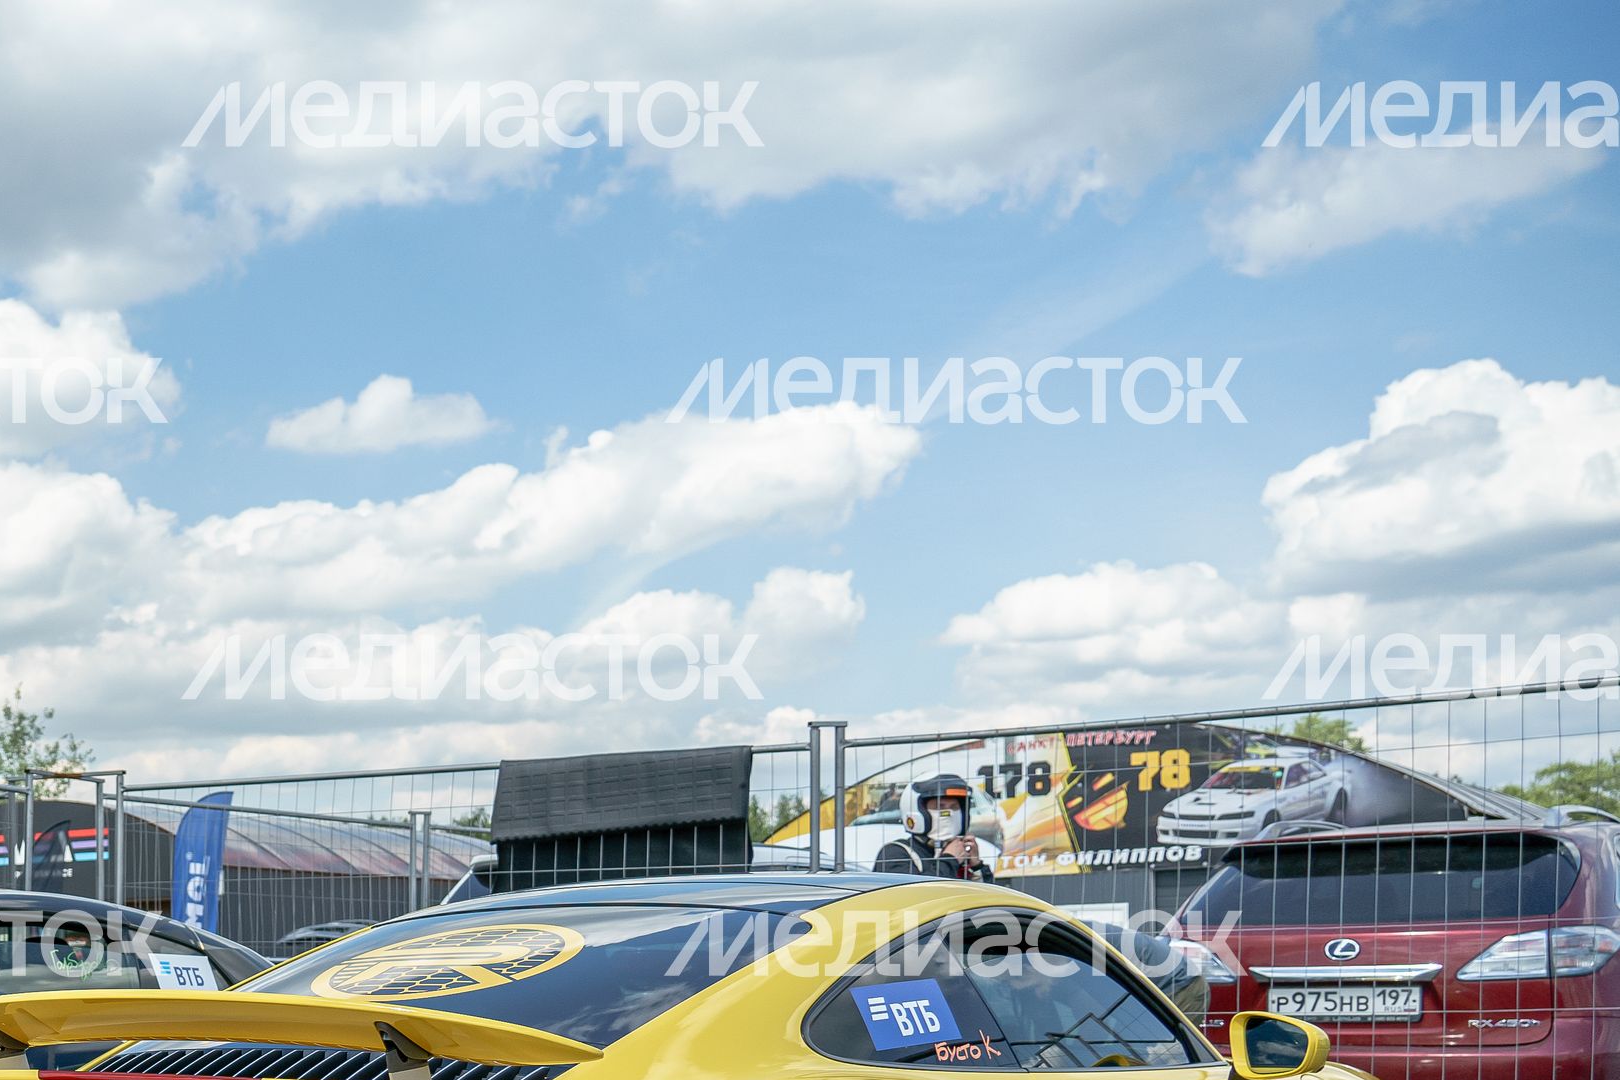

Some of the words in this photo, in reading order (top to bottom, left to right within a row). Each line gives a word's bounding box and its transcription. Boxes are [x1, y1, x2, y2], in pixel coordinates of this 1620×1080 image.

[1129, 748, 1192, 792] 78
[173, 966, 205, 987] ВТБ
[1377, 989, 1413, 1006] 197
[890, 999, 941, 1037] ВТБ
